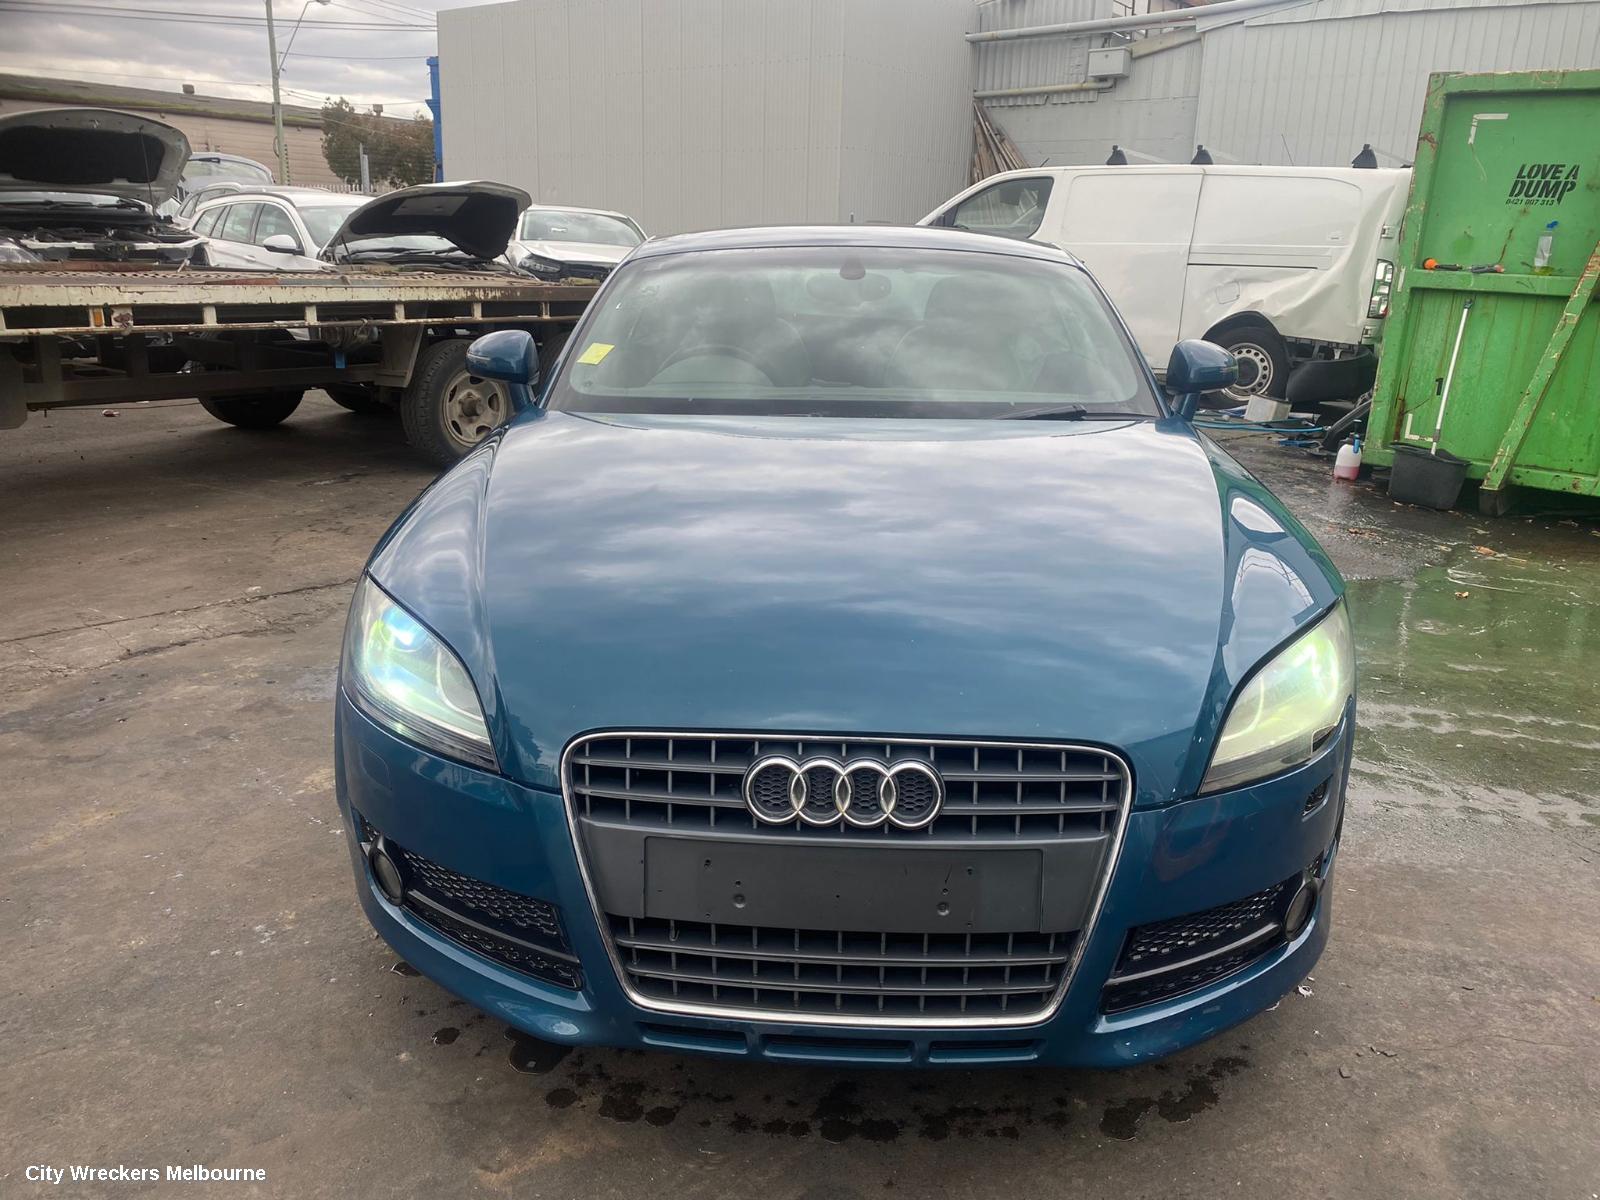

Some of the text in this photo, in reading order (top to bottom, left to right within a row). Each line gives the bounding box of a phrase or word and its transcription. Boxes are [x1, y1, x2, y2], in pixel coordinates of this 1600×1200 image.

[1516, 163, 1580, 180] LOVE A
[1508, 179, 1577, 205] DUMP
